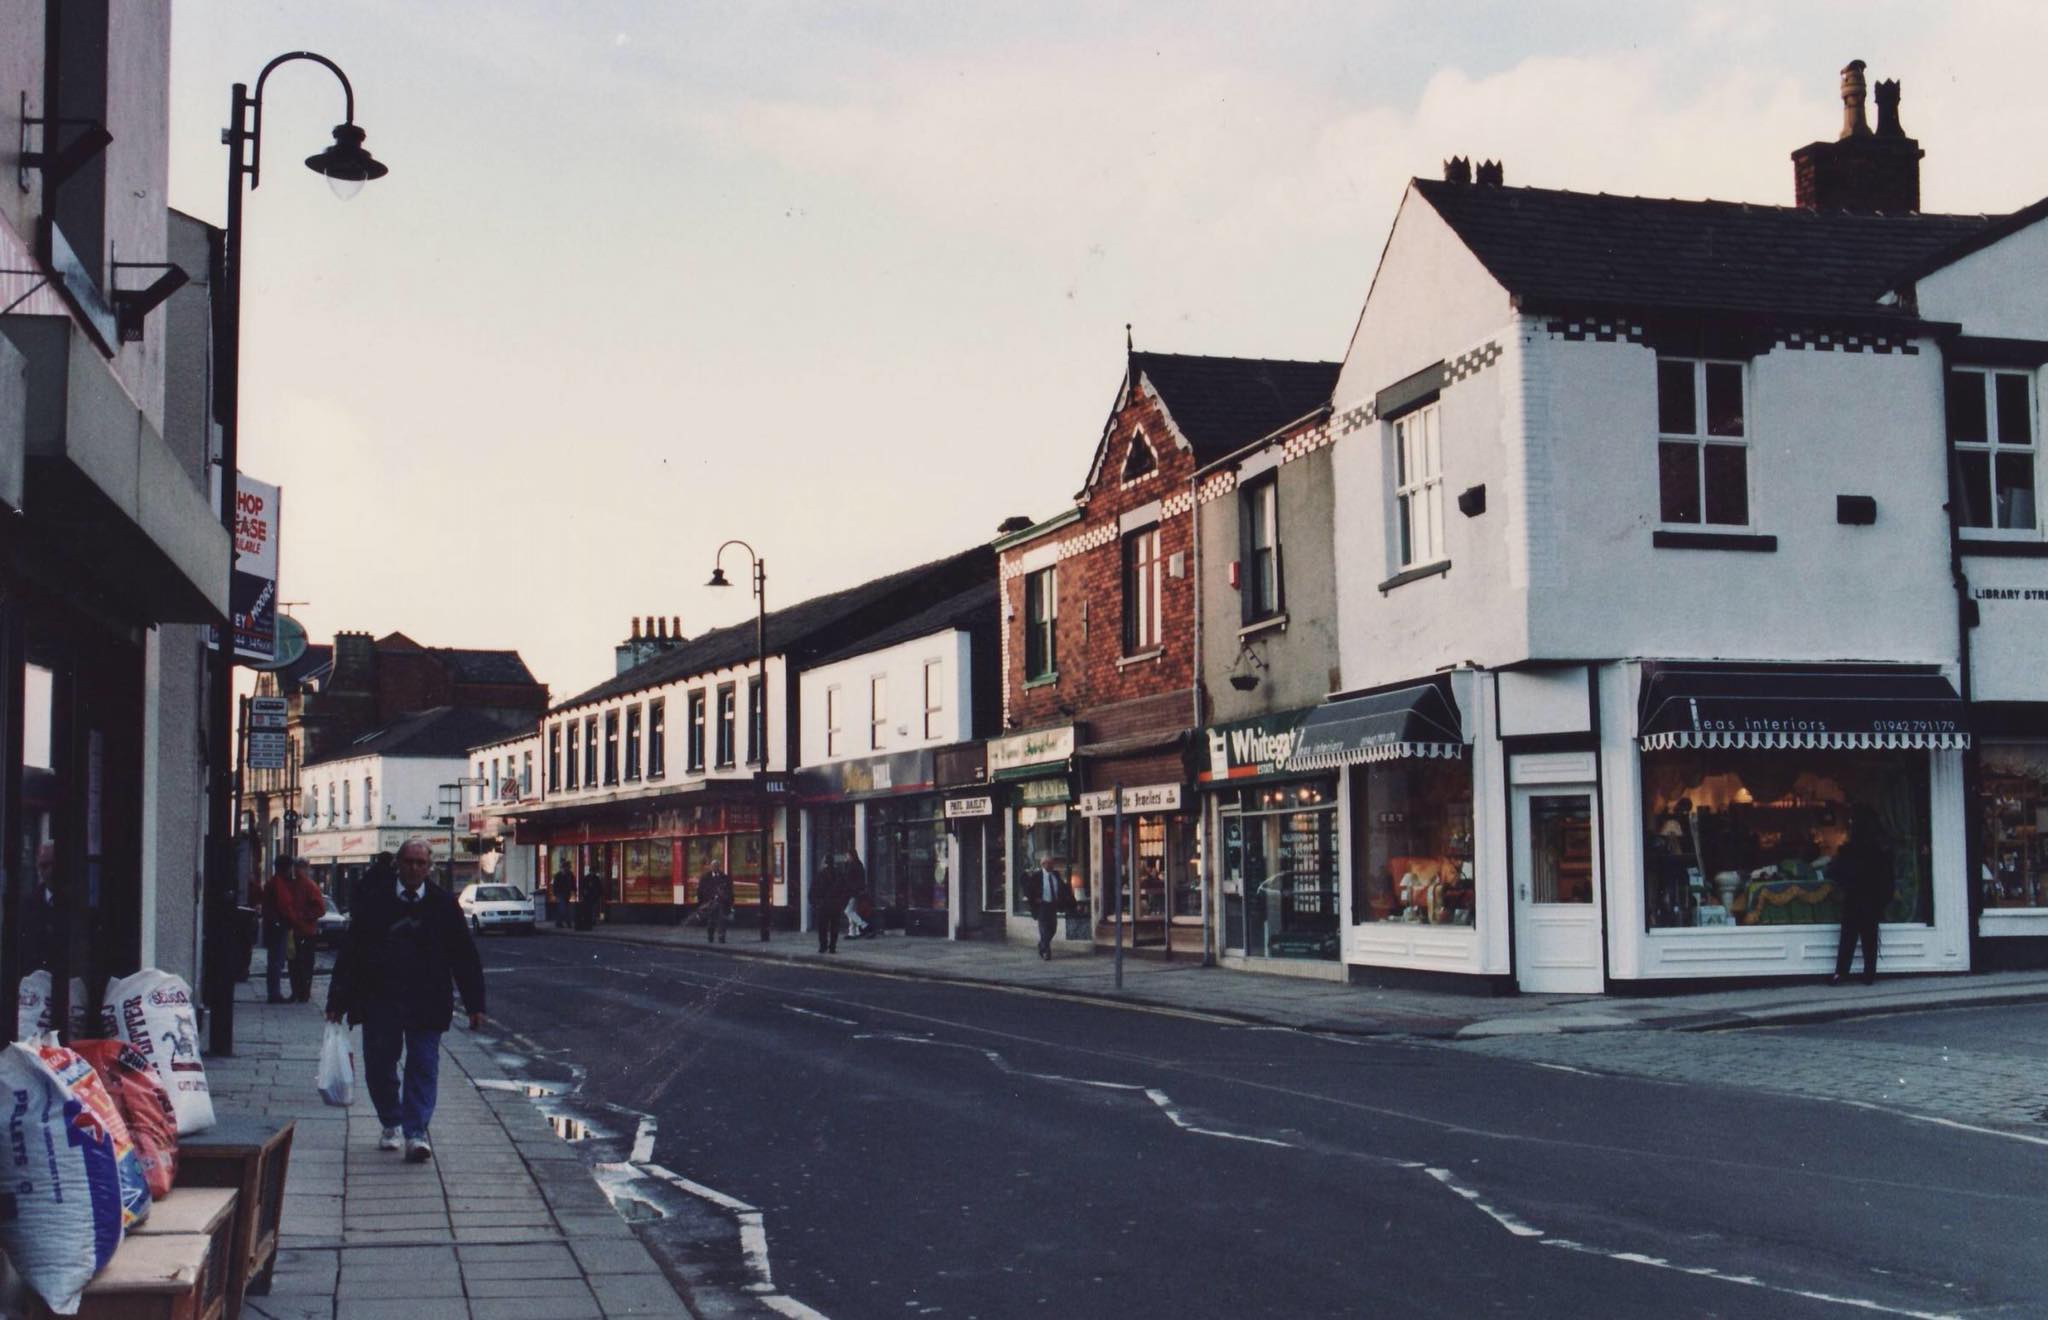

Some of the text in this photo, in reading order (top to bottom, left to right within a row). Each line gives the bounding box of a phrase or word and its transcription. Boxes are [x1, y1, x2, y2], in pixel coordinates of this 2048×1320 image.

[237, 491, 264, 516] HOP
[234, 516, 267, 542] EASE
[1976, 588, 2020, 600] LIBRARY
[1745, 717, 1825, 731] interiors
[1874, 720, 1909, 731] 01942
[1231, 726, 1296, 770] Whitegat
